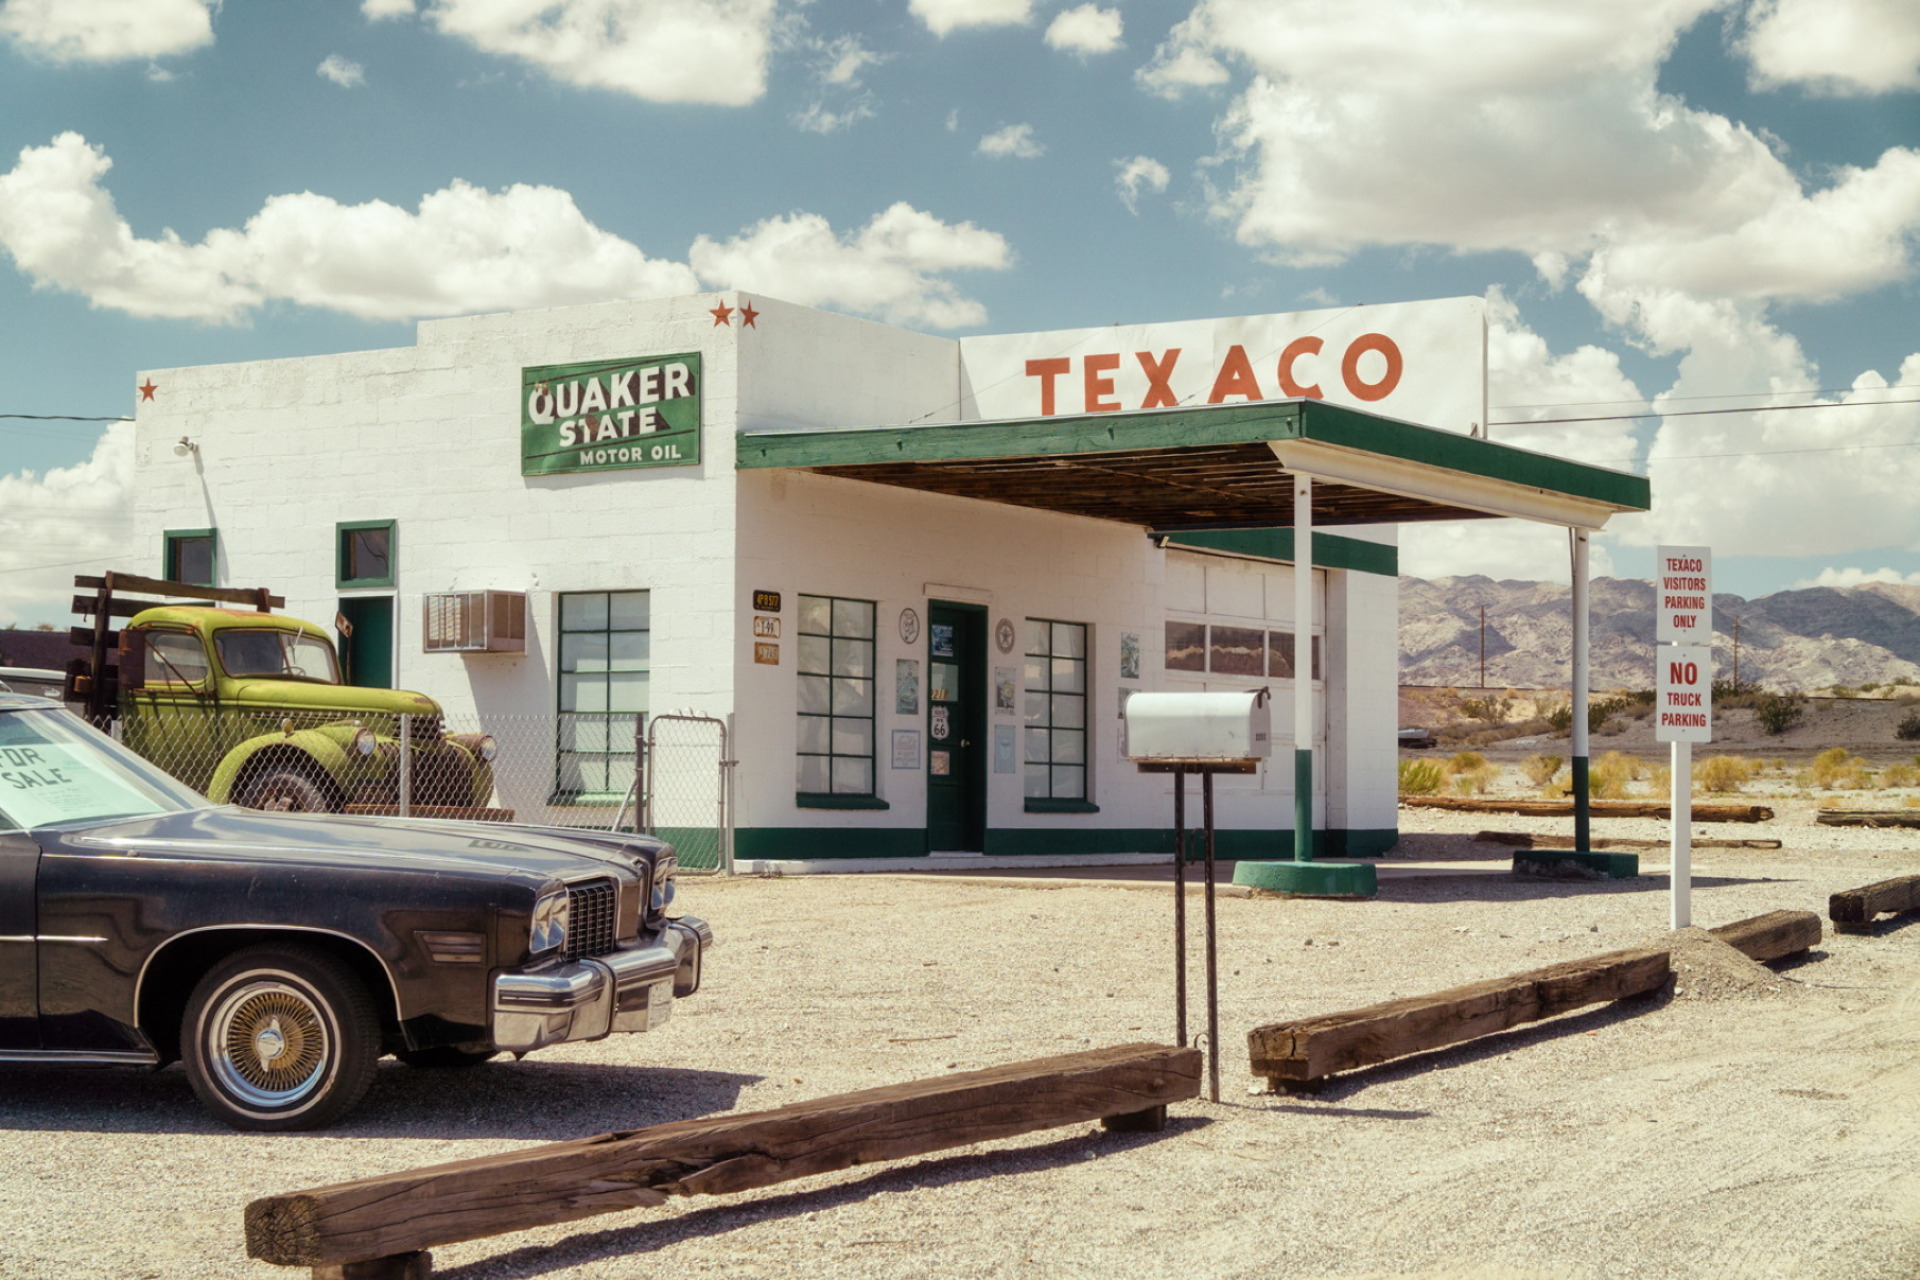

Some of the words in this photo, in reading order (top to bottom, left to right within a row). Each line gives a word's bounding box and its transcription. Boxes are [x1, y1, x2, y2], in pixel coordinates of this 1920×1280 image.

[1025, 332, 1403, 416] TEXACO
[528, 362, 690, 425] QUAKER
[559, 406, 657, 447] STATE
[580, 447, 643, 466] MOTOR
[651, 445, 682, 460] OIL
[1666, 558, 1702, 572] TEXACO
[1663, 577, 1706, 591] VISITORS
[1664, 596, 1705, 610] PARKING
[1673, 615, 1697, 628] ONLY
[1670, 662, 1698, 685] NO
[1667, 692, 1702, 706] TRUCK
[1661, 713, 1707, 727] PARKING
[934, 724, 946, 736] 66
[0, 748, 46, 768] OR
[1, 768, 72, 789] SALE
